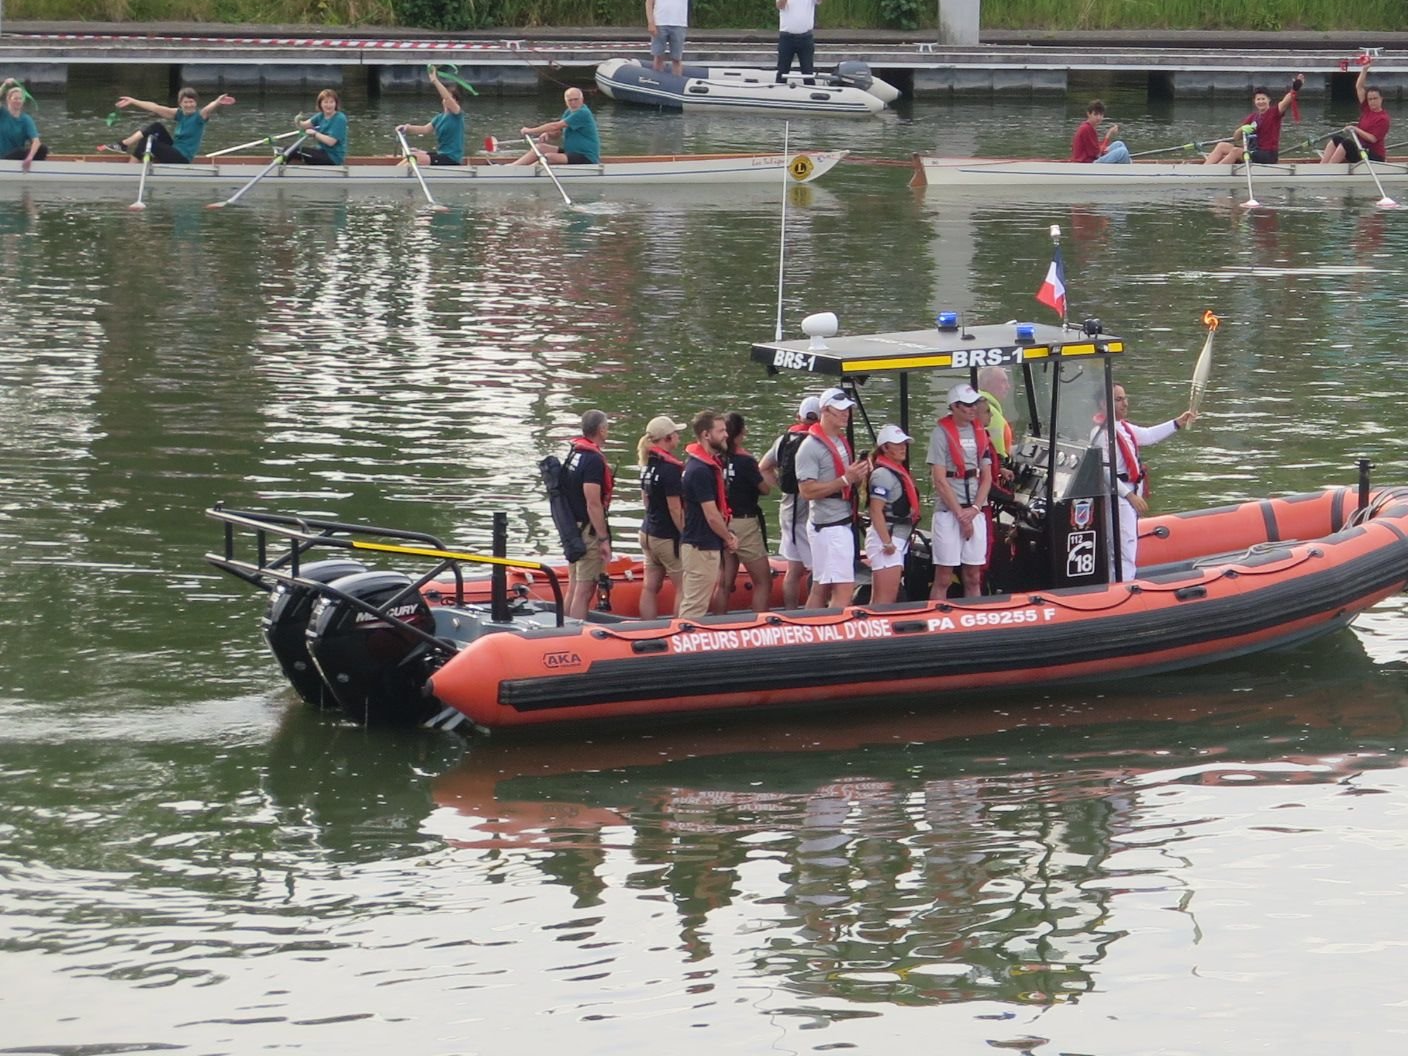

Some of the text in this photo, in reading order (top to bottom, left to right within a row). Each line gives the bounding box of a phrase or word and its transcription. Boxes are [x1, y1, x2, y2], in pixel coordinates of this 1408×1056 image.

[772, 350, 816, 372] BRS-1
[952, 347, 1024, 368] BRS-1
[1070, 534, 1083, 544] 112
[1074, 554, 1093, 572] 18
[928, 608, 1056, 632] PA G59255 F
[672, 619, 891, 654] SAPEURS POMPIERS VAL D'OISE
[548, 654, 582, 664] AKA
